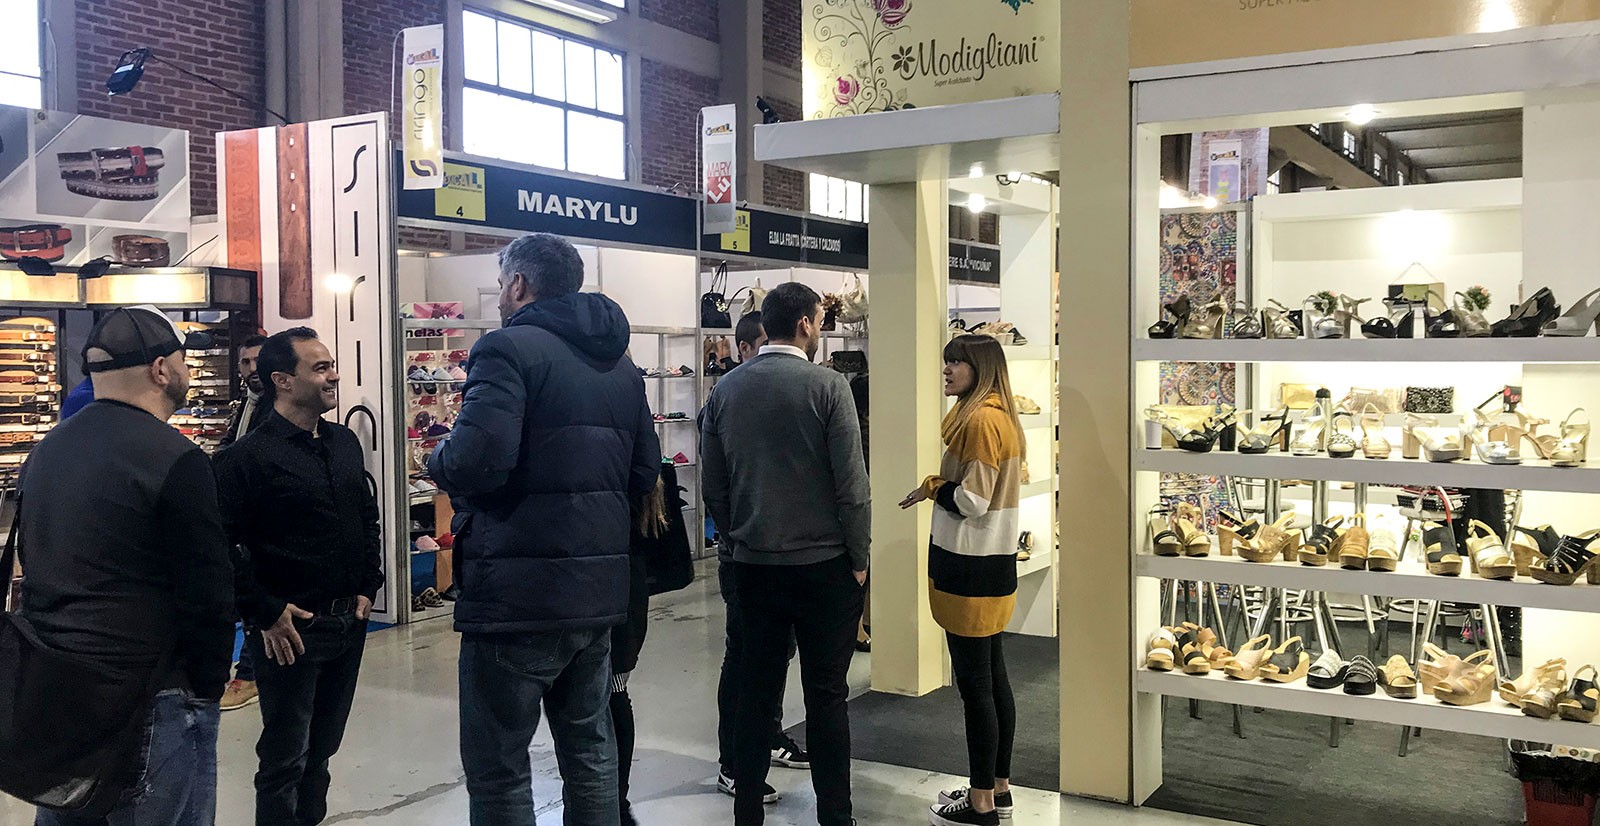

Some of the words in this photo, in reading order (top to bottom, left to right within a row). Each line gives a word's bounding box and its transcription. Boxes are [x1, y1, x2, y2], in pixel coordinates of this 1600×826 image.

[900, 32, 1038, 81] Modigliani
[456, 206, 463, 217] 4
[517, 189, 638, 226] MARYLU
[732, 241, 738, 250] 5
